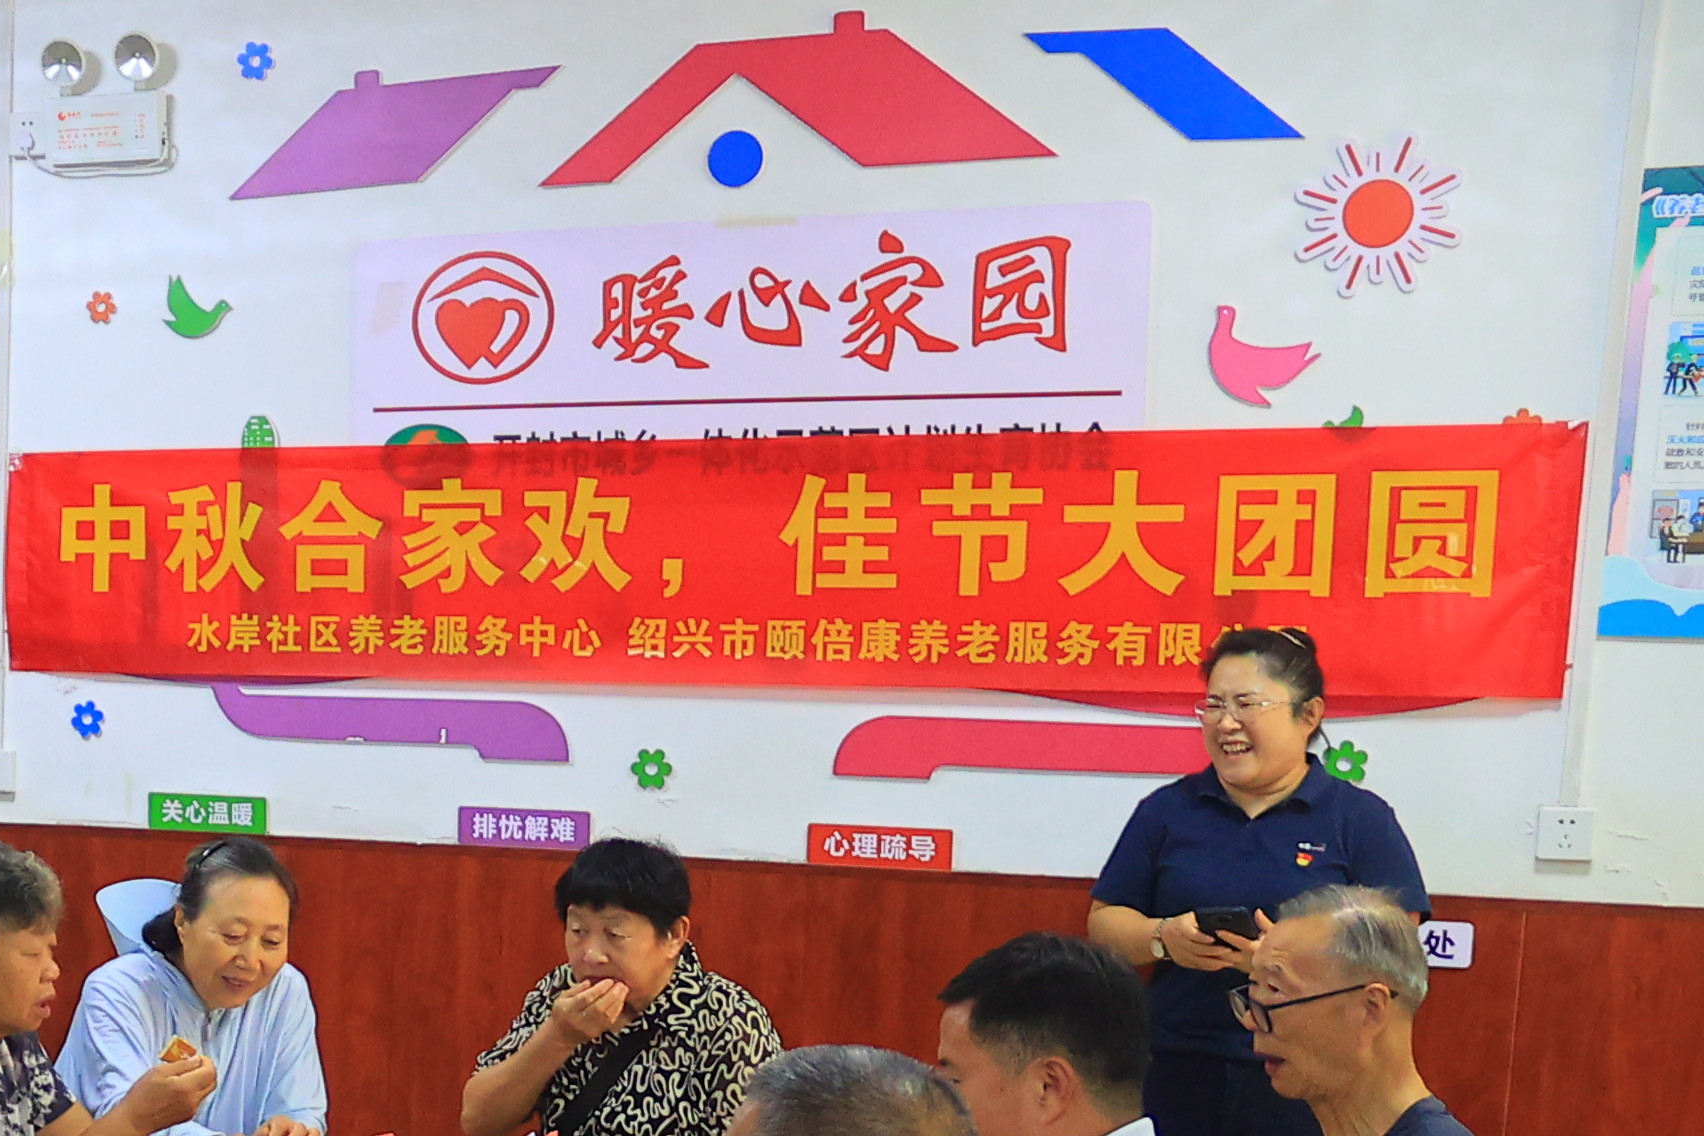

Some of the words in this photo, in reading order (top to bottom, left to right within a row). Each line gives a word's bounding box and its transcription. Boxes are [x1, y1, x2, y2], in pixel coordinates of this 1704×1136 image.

[592, 229, 1071, 370] 暖心家园
[778, 468, 1499, 600] 佳节大团圆
[186, 612, 603, 658] 水岸社区养老服务中心
[627, 616, 1309, 667] 绍兴市颐倍康养老服务有限
[161, 798, 254, 827] 关心温暖
[471, 811, 576, 843] 排忧解难
[822, 831, 937, 863] 心理疏导
[1423, 928, 1456, 960] 处
